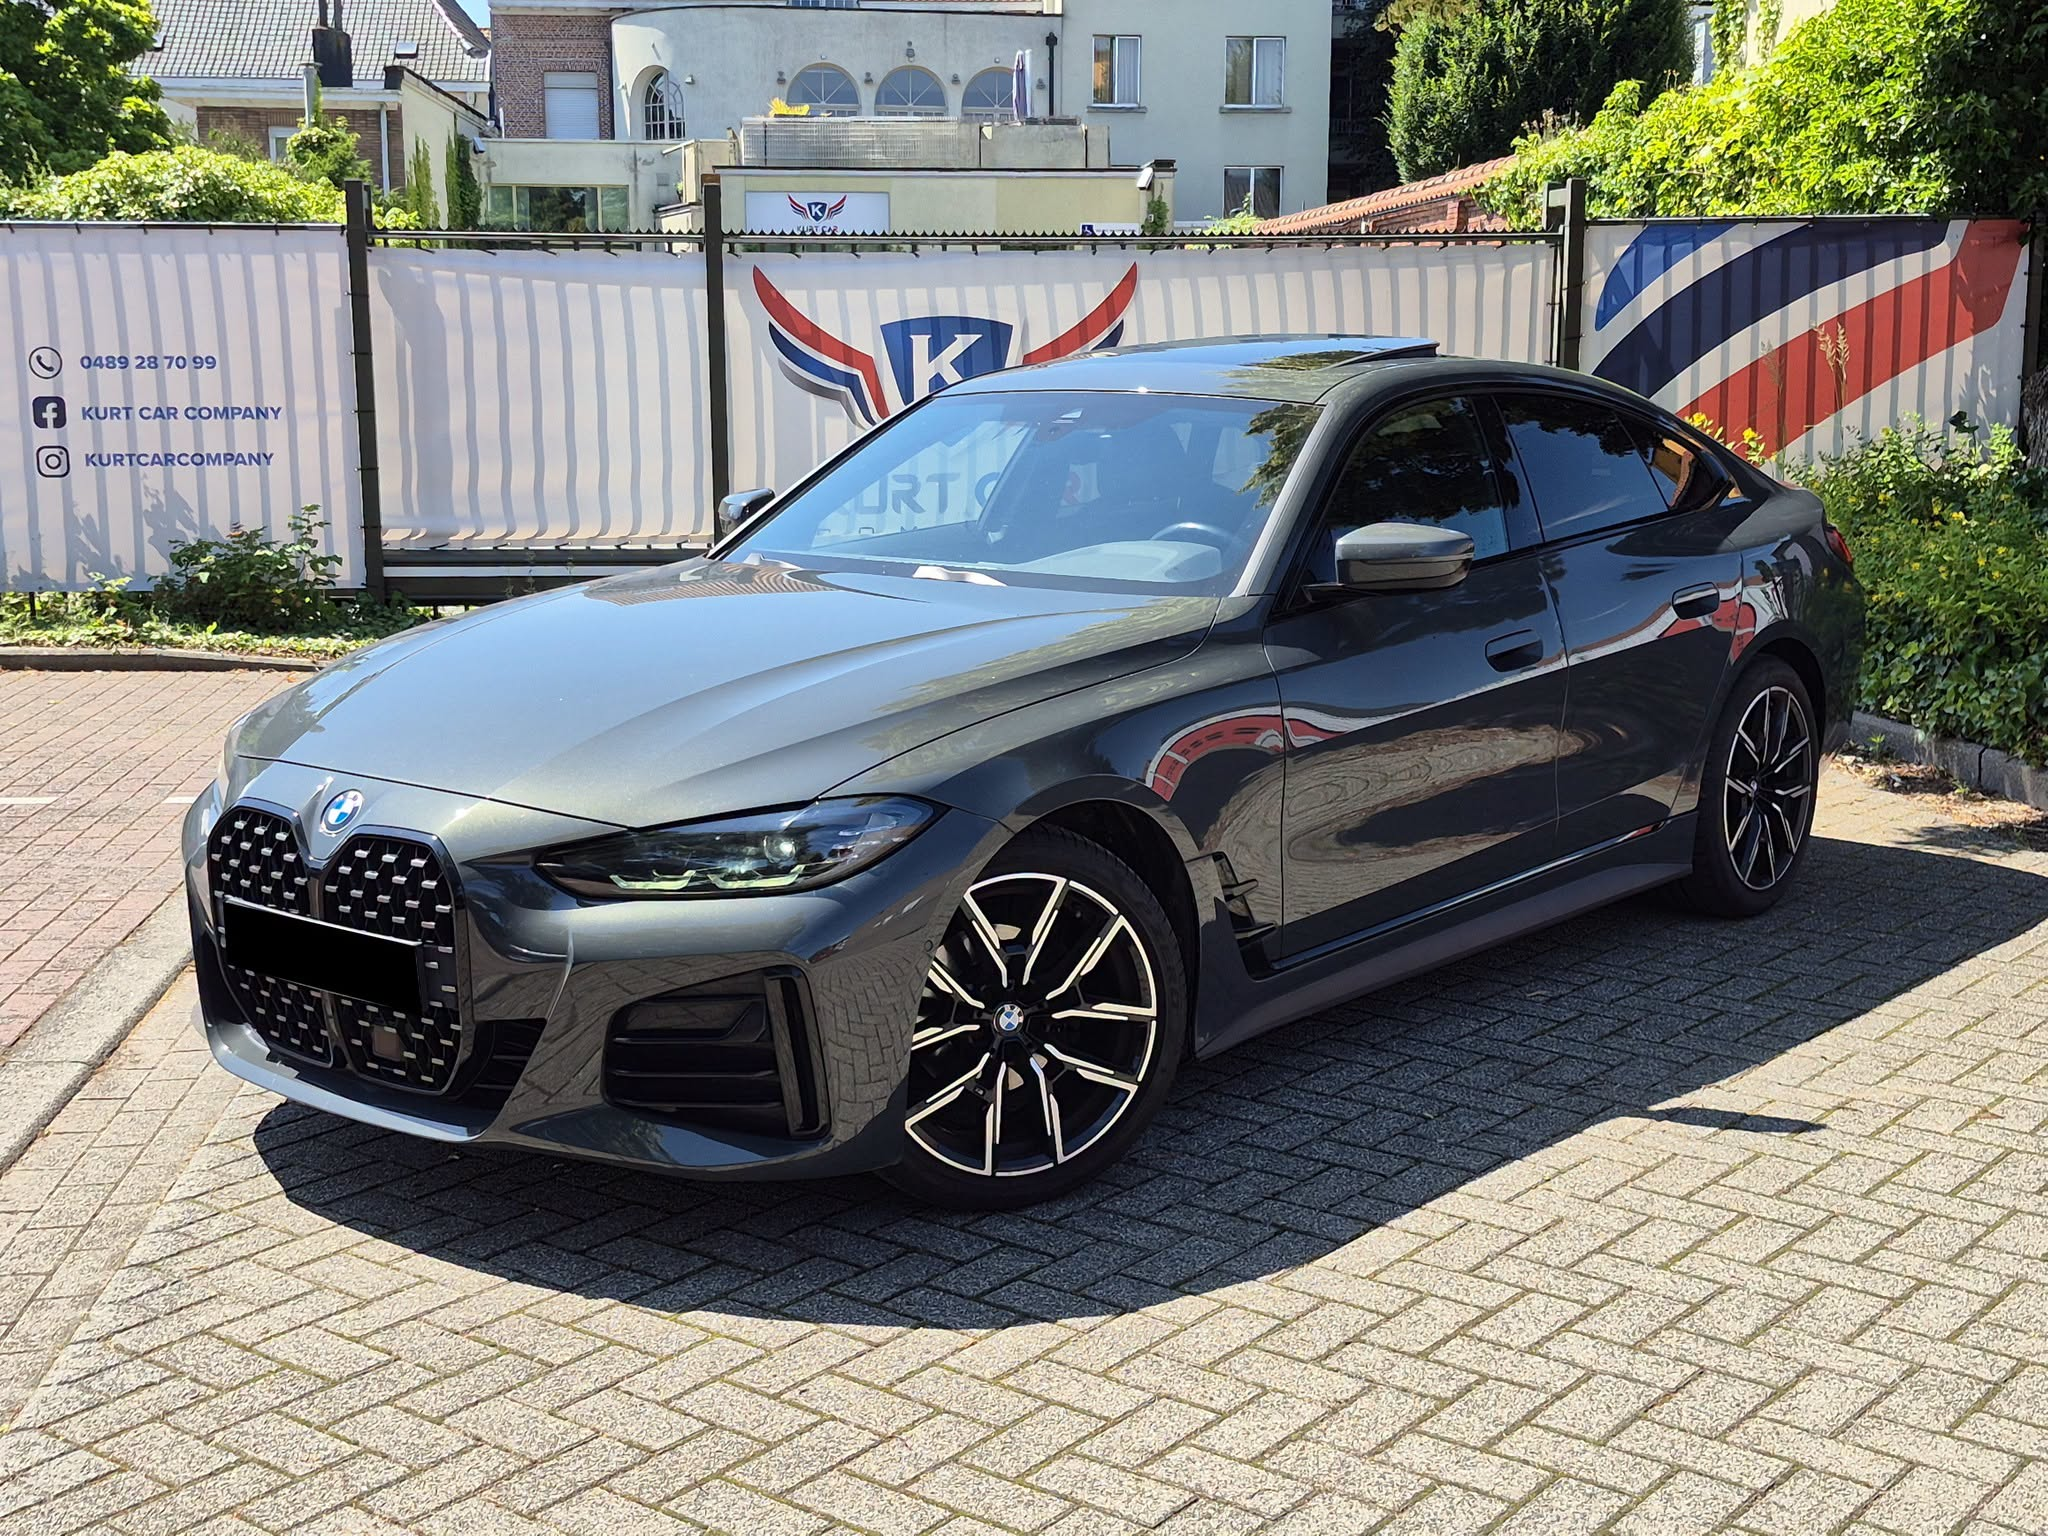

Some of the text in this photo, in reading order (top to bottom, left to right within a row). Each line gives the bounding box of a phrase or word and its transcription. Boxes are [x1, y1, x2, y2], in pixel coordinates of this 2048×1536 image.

[811, 205, 822, 216] K
[79, 355, 217, 370] 0489 28 70 99
[909, 333, 983, 402] K
[81, 406, 282, 420] KURT CAR COMPANY
[85, 453, 274, 467] KURTCARCOMPANY
[837, 472, 961, 514] URT
